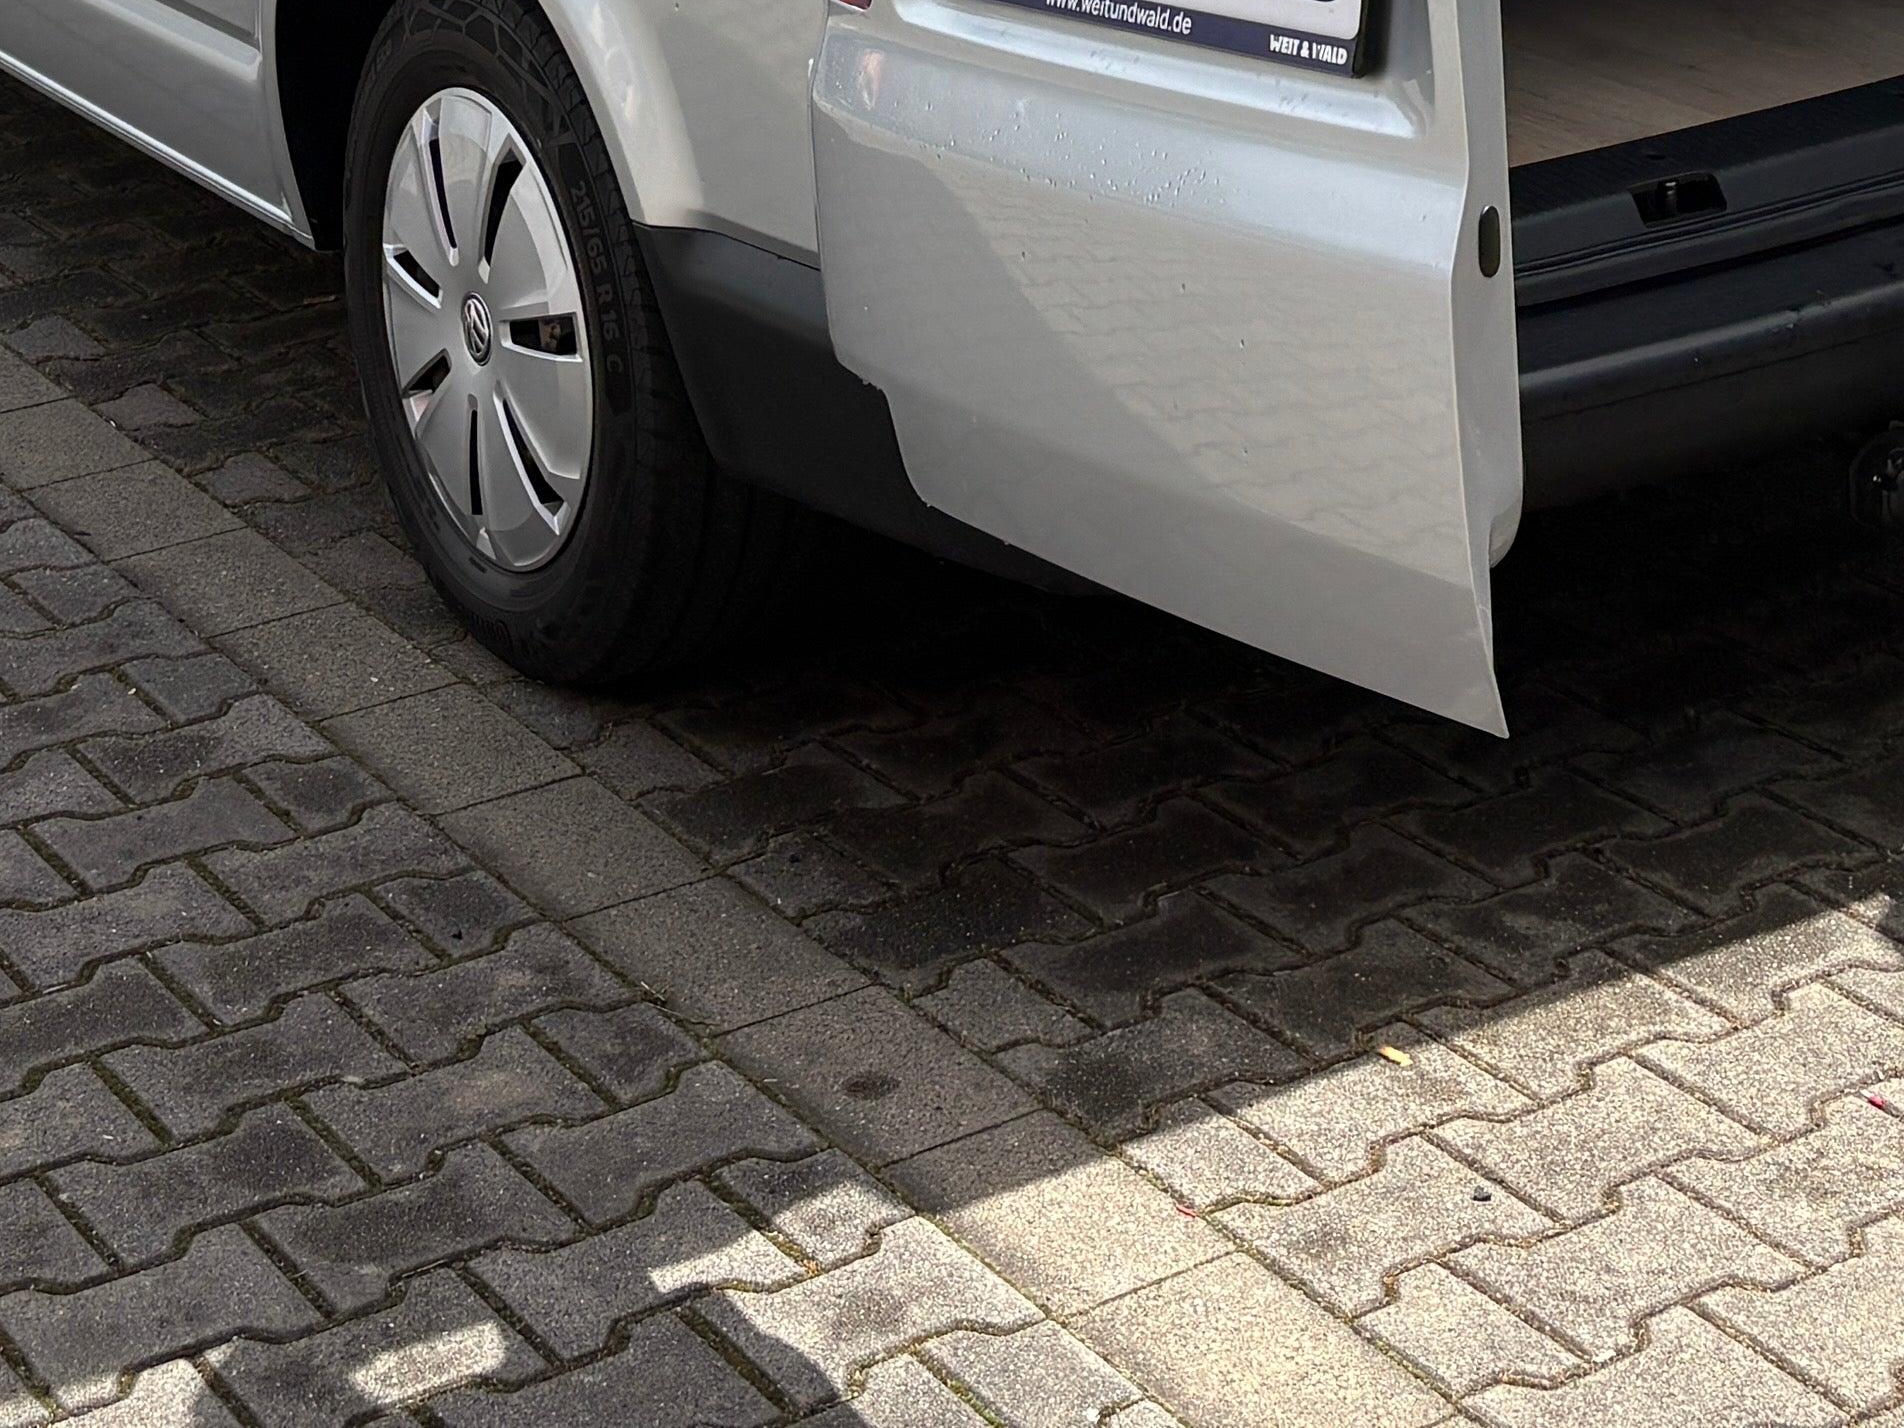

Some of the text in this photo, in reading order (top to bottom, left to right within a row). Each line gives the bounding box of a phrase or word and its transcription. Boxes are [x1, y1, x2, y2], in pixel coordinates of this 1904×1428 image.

[1269, 33, 1348, 66] WEIT & WALD
[570, 180, 608, 276] 215/65
[595, 284, 613, 305] R
